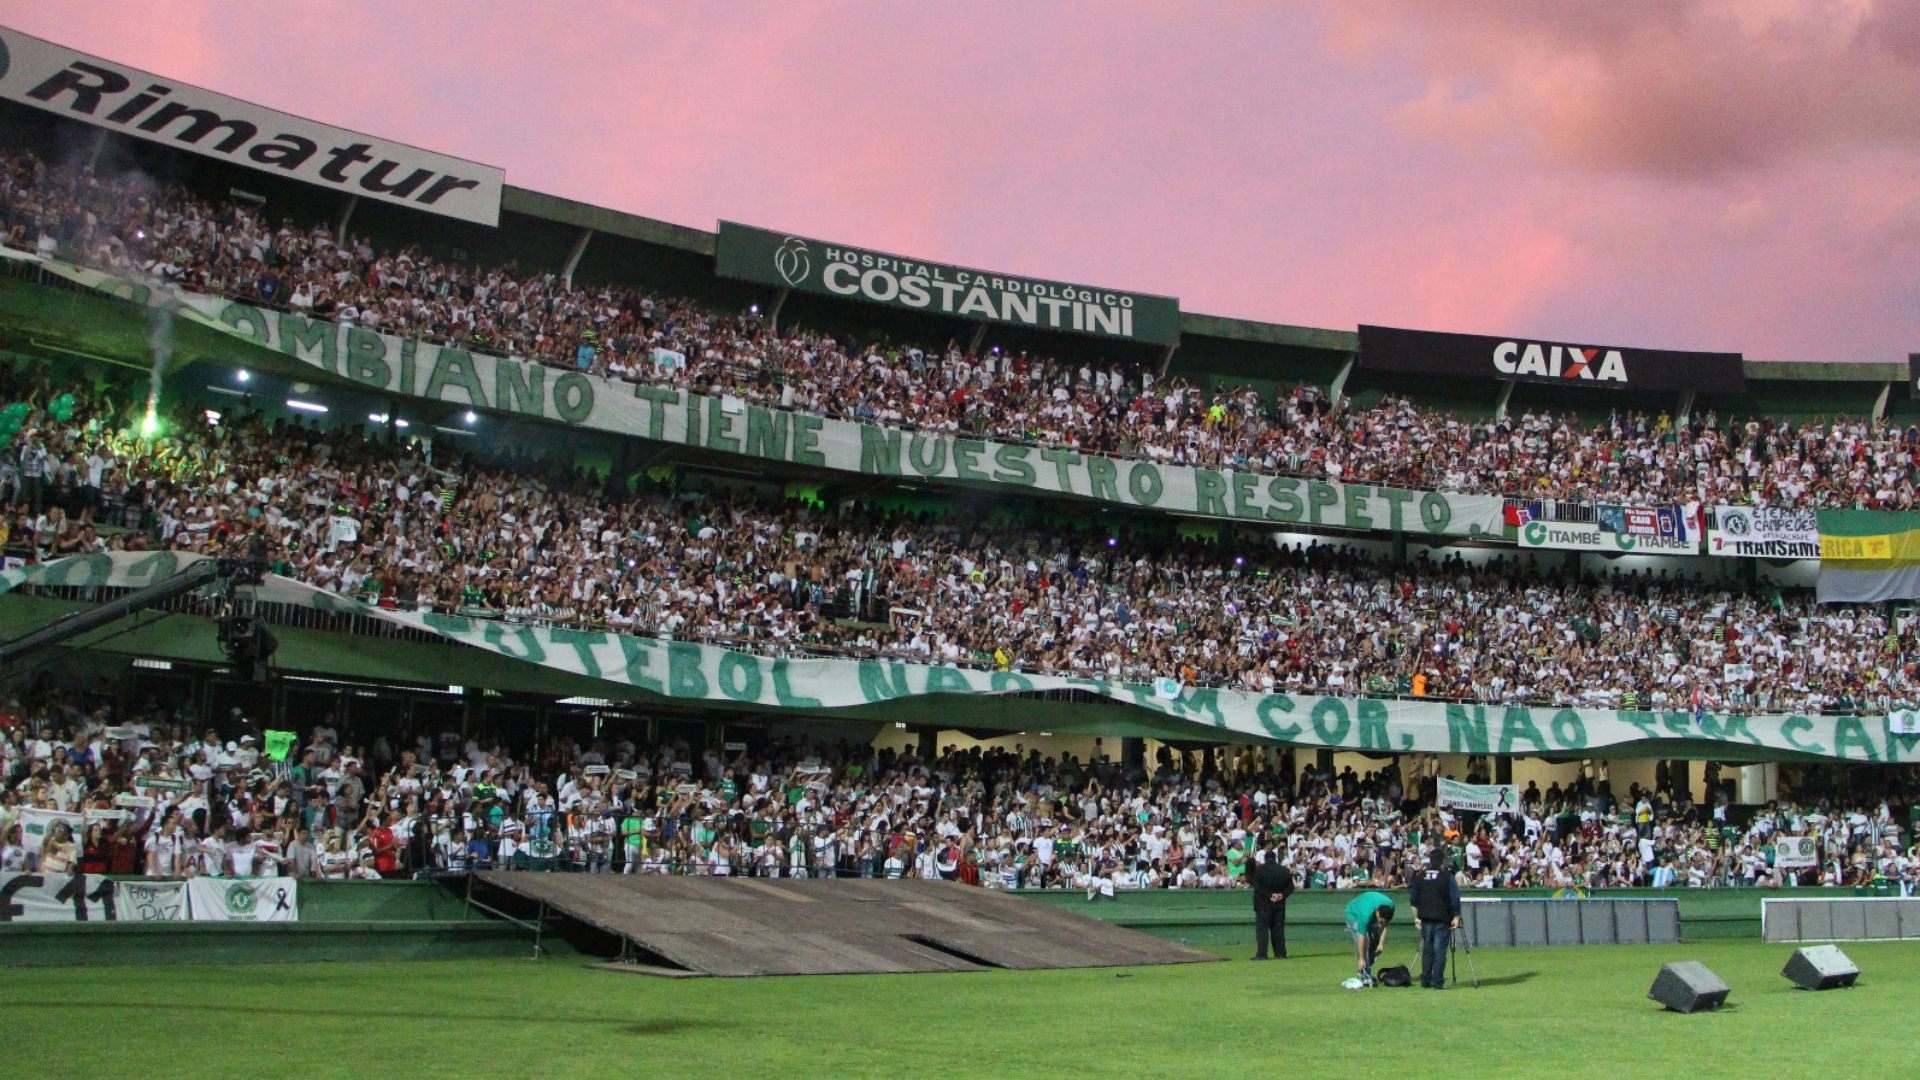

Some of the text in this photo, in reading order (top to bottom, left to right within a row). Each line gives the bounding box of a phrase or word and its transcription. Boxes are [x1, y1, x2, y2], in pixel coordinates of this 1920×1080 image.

[25, 61, 480, 204] Rimatur
[823, 263, 1133, 336] COSTANTINI
[826, 247, 1134, 308] HOSPITAL CARDIOLÓGICO
[1492, 341, 1628, 382] CAIXA
[635, 384, 825, 466] TIENE
[860, 425, 1163, 506] NUESTRO
